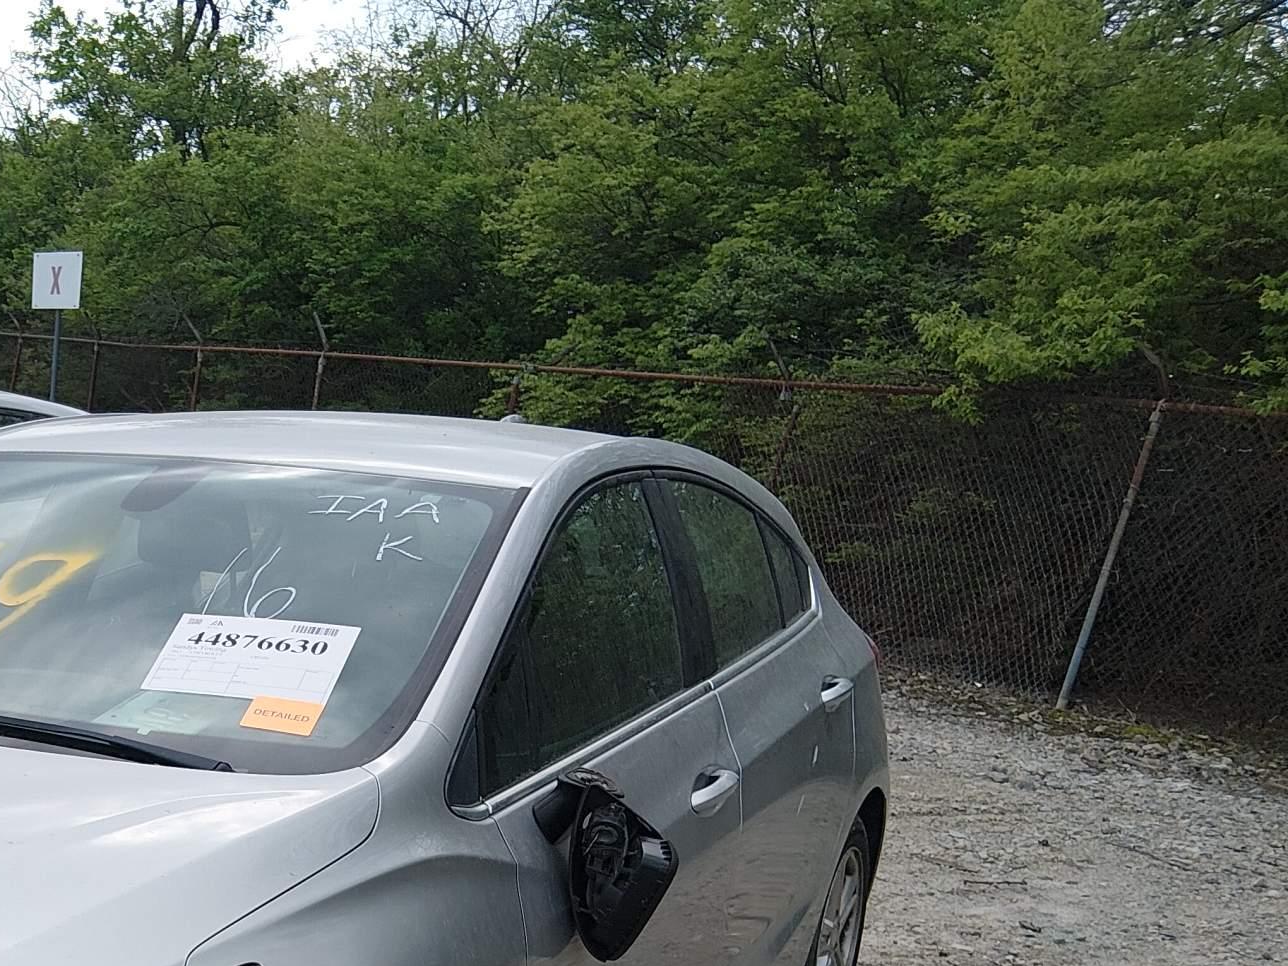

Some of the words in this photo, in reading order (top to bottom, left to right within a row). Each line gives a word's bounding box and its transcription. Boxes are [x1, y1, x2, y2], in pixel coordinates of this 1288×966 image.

[50, 265, 62, 295] X
[307, 495, 440, 523] IAA
[375, 532, 423, 561] K
[201, 546, 297, 619] 16
[187, 631, 329, 656] 44876630
[253, 708, 310, 723] DETAILED
